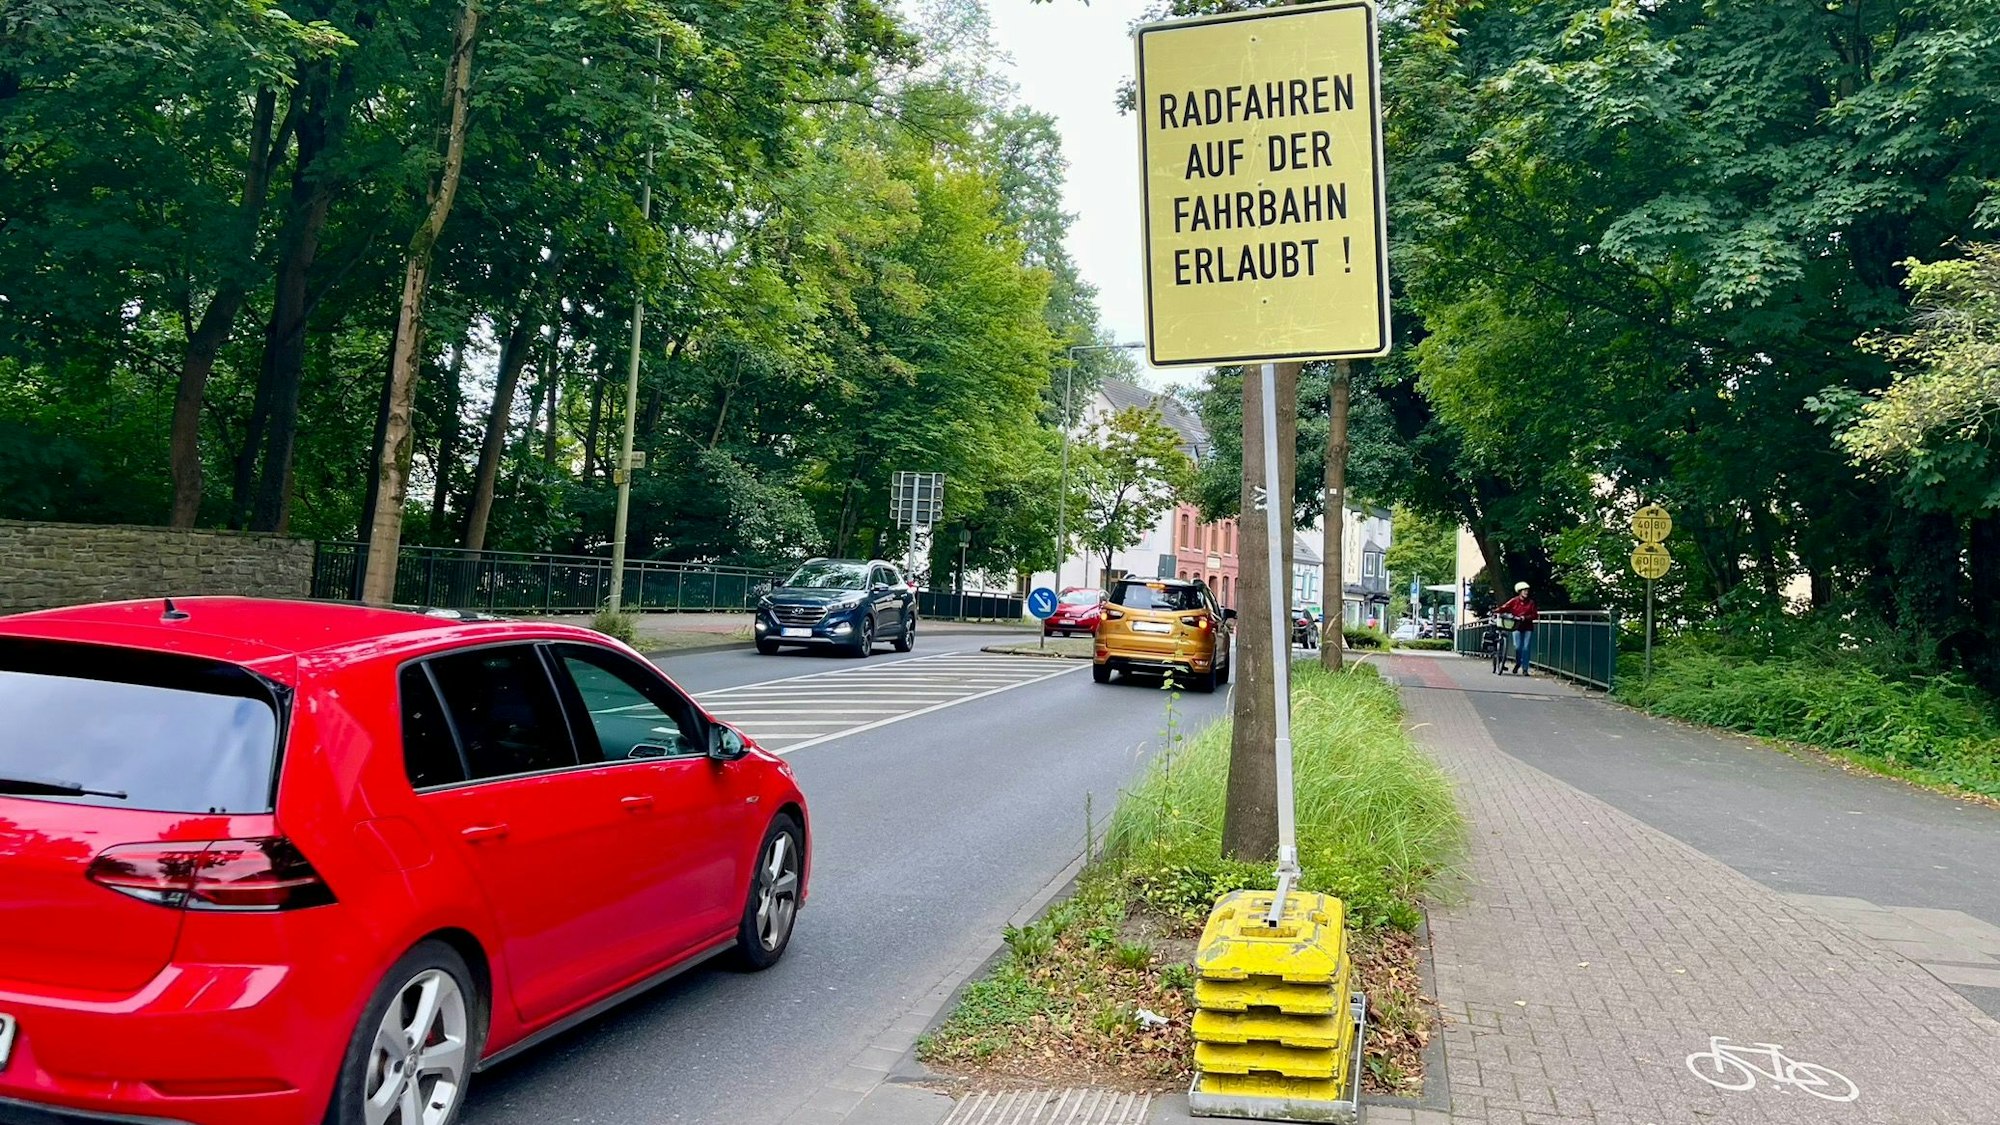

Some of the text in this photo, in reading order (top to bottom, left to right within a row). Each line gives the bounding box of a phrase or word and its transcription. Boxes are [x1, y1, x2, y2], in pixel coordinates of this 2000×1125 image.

[1160, 73, 1354, 130] RADFAHREN
[1185, 130, 1332, 180] AUF DER
[1173, 182, 1347, 233] FAHRBAHN
[1175, 236, 1351, 286] ERLAUBT !
[1638, 520, 1666, 530] 40 80
